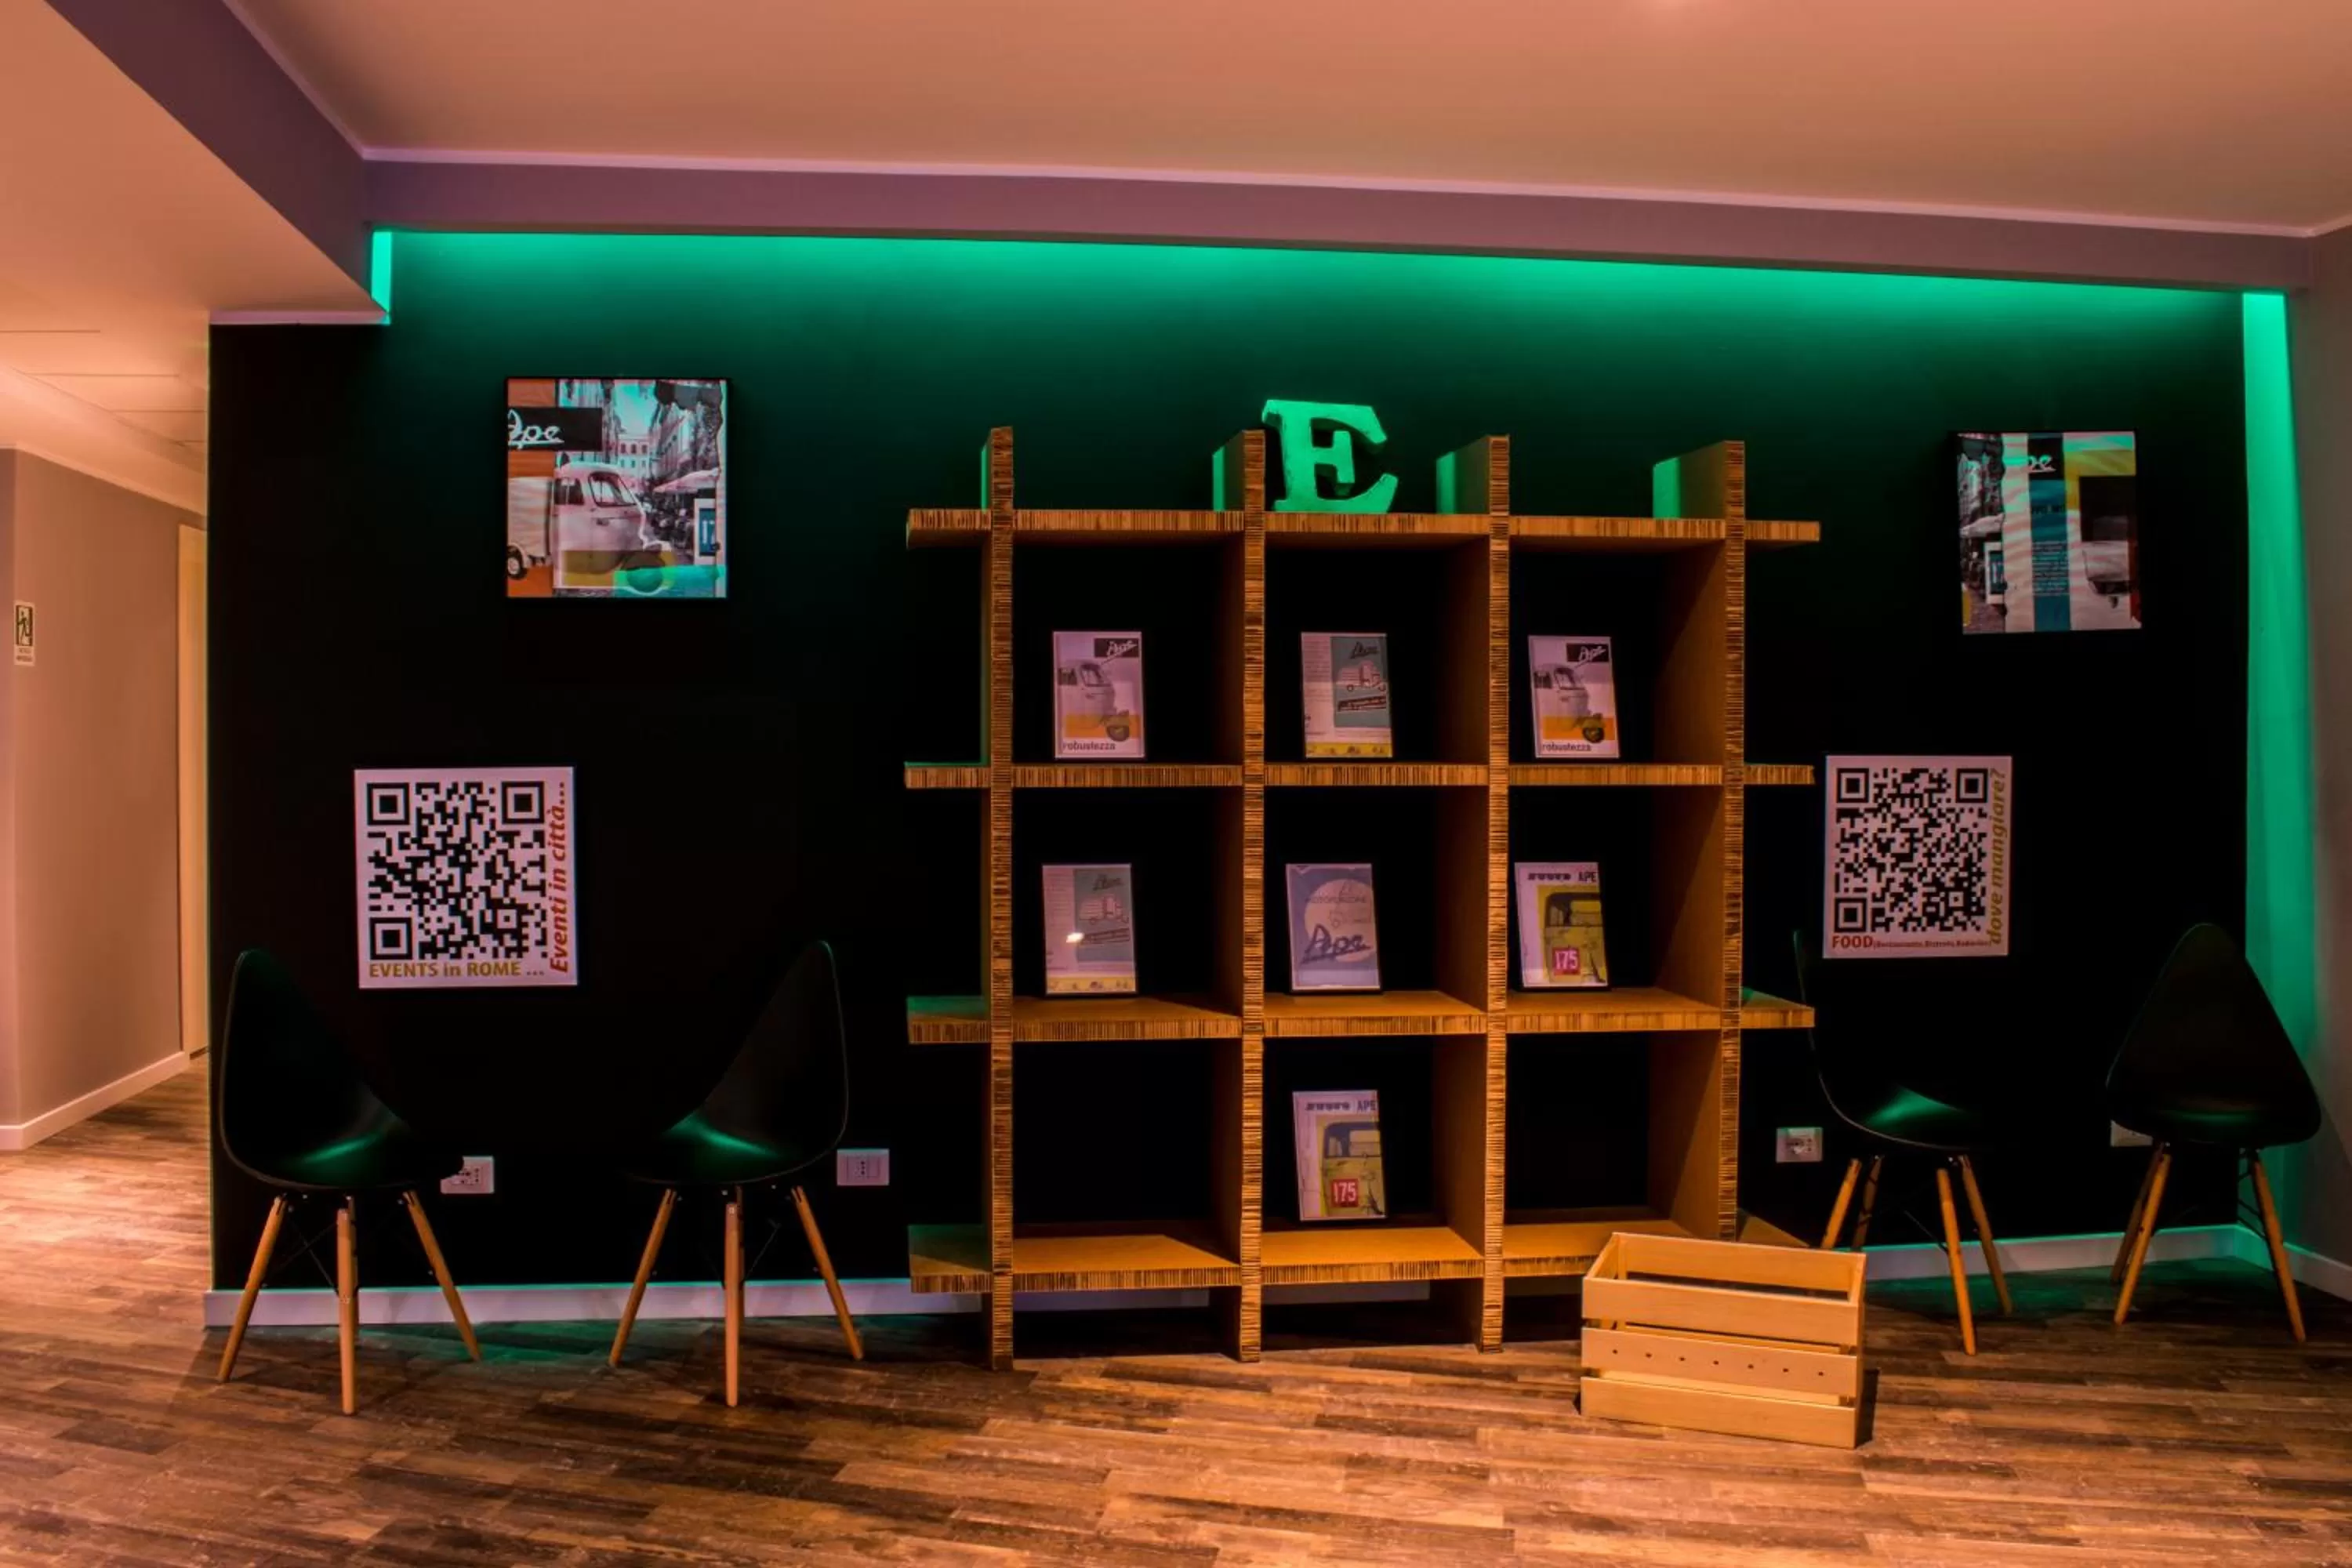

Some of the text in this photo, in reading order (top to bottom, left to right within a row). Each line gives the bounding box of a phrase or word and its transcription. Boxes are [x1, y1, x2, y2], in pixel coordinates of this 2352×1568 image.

[1262, 399, 1398, 514] E
[1987, 768, 2008, 944] dove mangiare?
[548, 868, 567, 891] in
[549, 896, 568, 973] Eventi
[1301, 924, 1372, 965] Ape
[1832, 935, 1873, 949] FOOD
[368, 962, 438, 978] EVENTS
[443, 961, 462, 977] in
[466, 960, 521, 976] ROME
[1555, 949, 1578, 970] 175
[1333, 1181, 1356, 1203] 175
